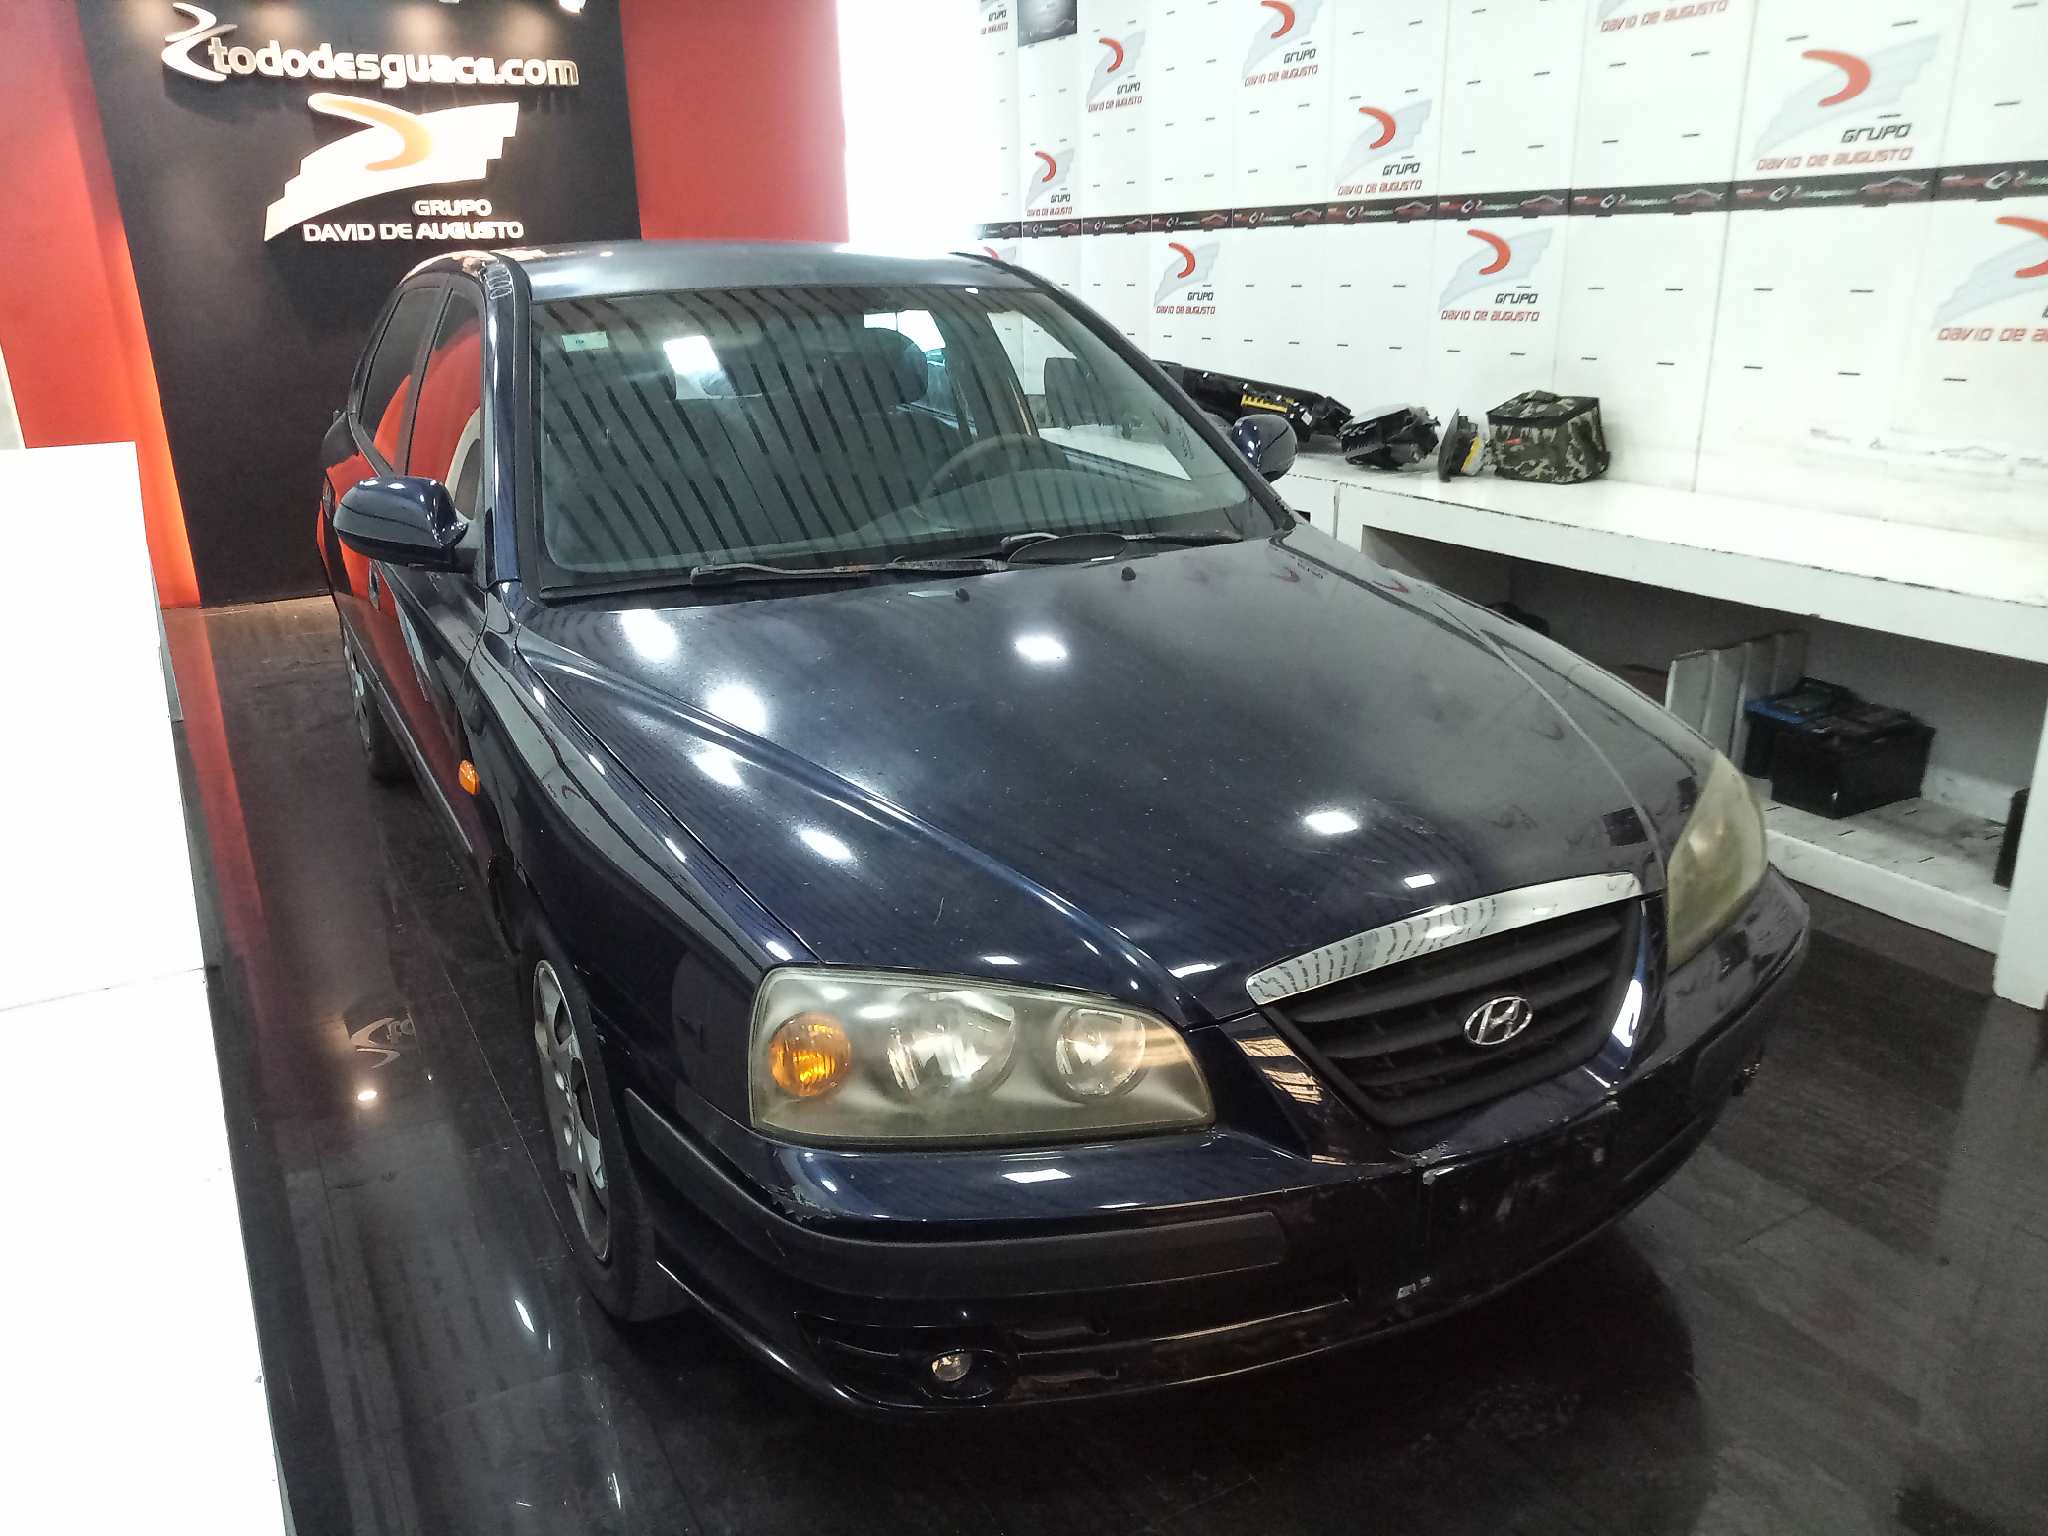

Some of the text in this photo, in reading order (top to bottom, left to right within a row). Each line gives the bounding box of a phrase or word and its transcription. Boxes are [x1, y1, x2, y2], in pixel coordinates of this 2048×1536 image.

[1284, 48, 1316, 64] GRUPO
[1841, 123, 1912, 143] GRUPO
[1382, 162, 1420, 176] GRUPO
[413, 199, 493, 216] GRUPO
[303, 221, 524, 242] DAVID DE AUGUSTO
[1187, 291, 1214, 301] GRUPO
[1495, 293, 1538, 304] GRUPO
